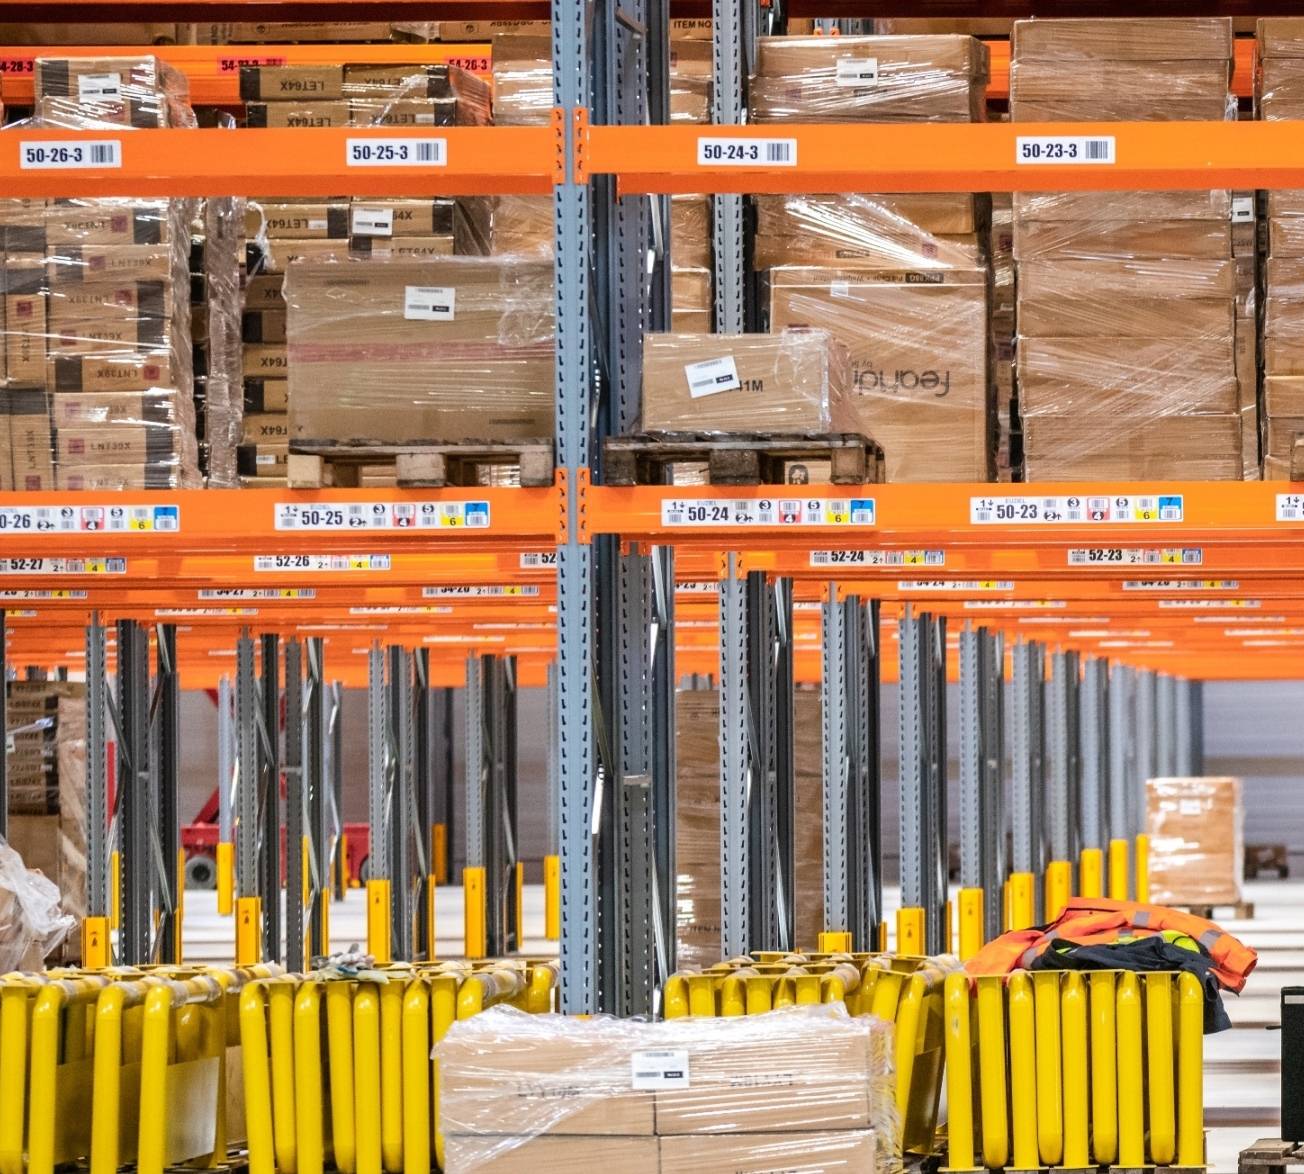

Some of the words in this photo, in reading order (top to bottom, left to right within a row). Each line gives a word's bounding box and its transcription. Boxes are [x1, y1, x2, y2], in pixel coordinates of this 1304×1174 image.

[673, 20, 697, 29] ITEM
[0, 60, 33, 72] 4-28-3
[26, 147, 83, 163] 50-26-3
[352, 145, 408, 161] 50-25-3
[703, 143, 759, 160] 50-24-3
[1022, 142, 1078, 158] 50-23-3
[301, 511, 342, 525] 50-25
[449, 518, 456, 526] 6
[688, 506, 729, 521] 50-24
[835, 515, 842, 523] 6
[997, 504, 1038, 518] 50-23
[1143, 511, 1150, 519] 6
[0, 514, 31, 529] 0-26
[140, 522, 146, 530] 6
[275, 555, 310, 567] 52-26
[831, 551, 865, 562] 52-24
[910, 556, 917, 564] 4
[1088, 549, 1123, 562] 52-23
[1167, 555, 1175, 563] 4
[10, 558, 43, 570] 52-27
[91, 564, 98, 572] 4
